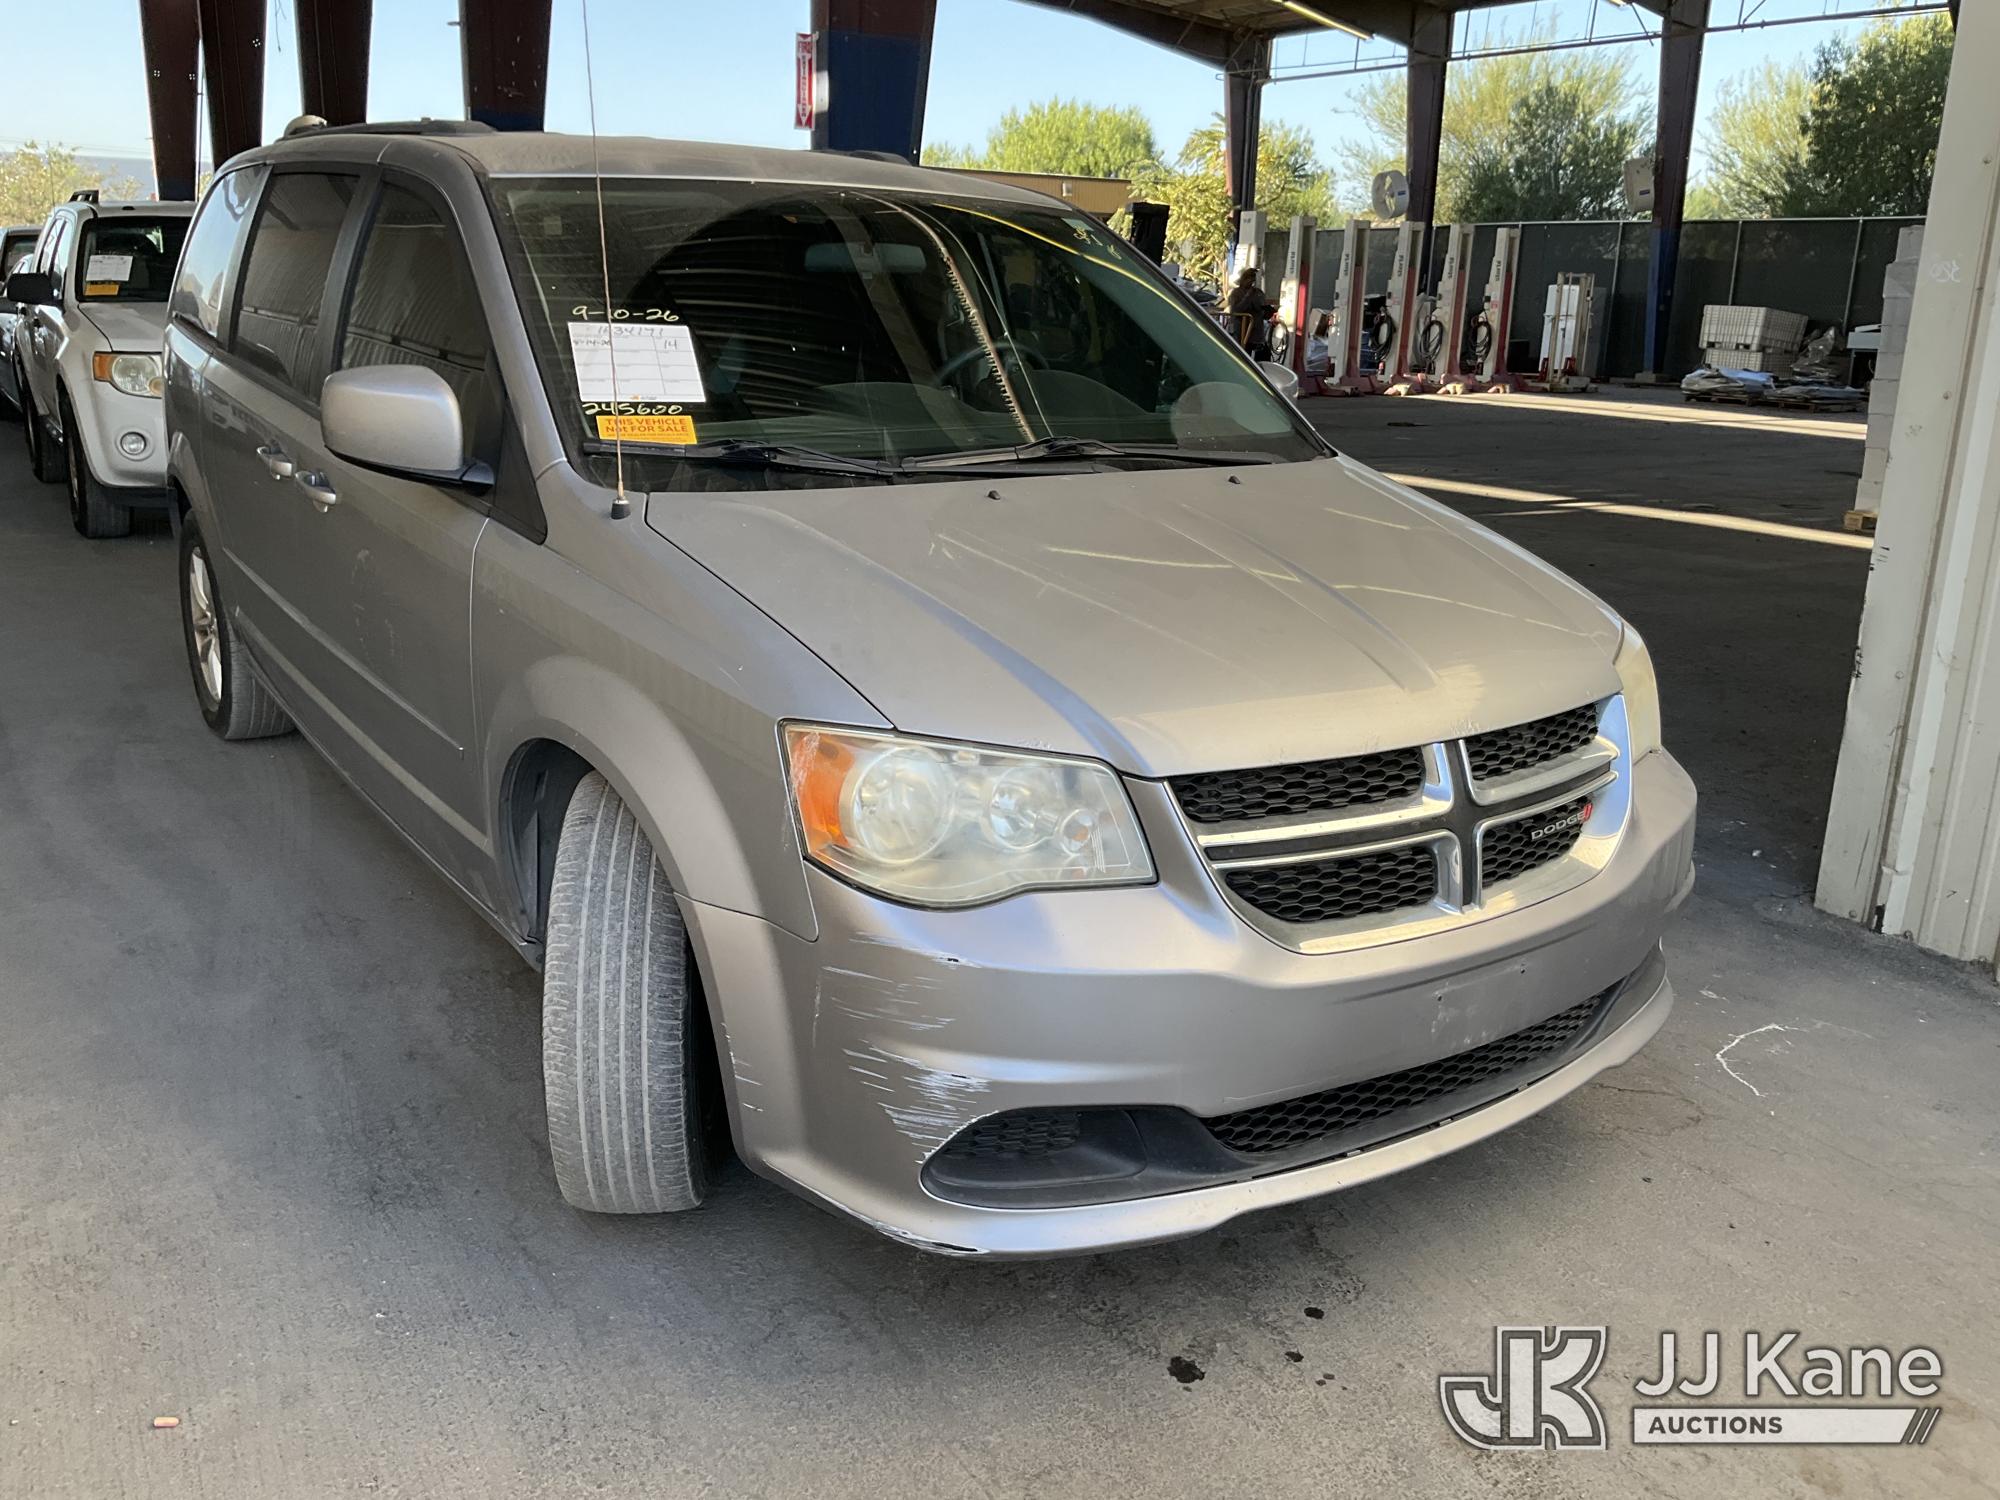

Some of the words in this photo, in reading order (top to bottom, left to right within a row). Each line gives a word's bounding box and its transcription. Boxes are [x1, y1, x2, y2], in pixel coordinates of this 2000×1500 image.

[605, 418, 634, 426] THIS
[635, 418, 686, 426] VEHICLE
[606, 425, 629, 433] Not
[631, 425, 656, 433] FOR
[657, 425, 688, 433] SALE
[1531, 811, 1585, 841] DODGE
